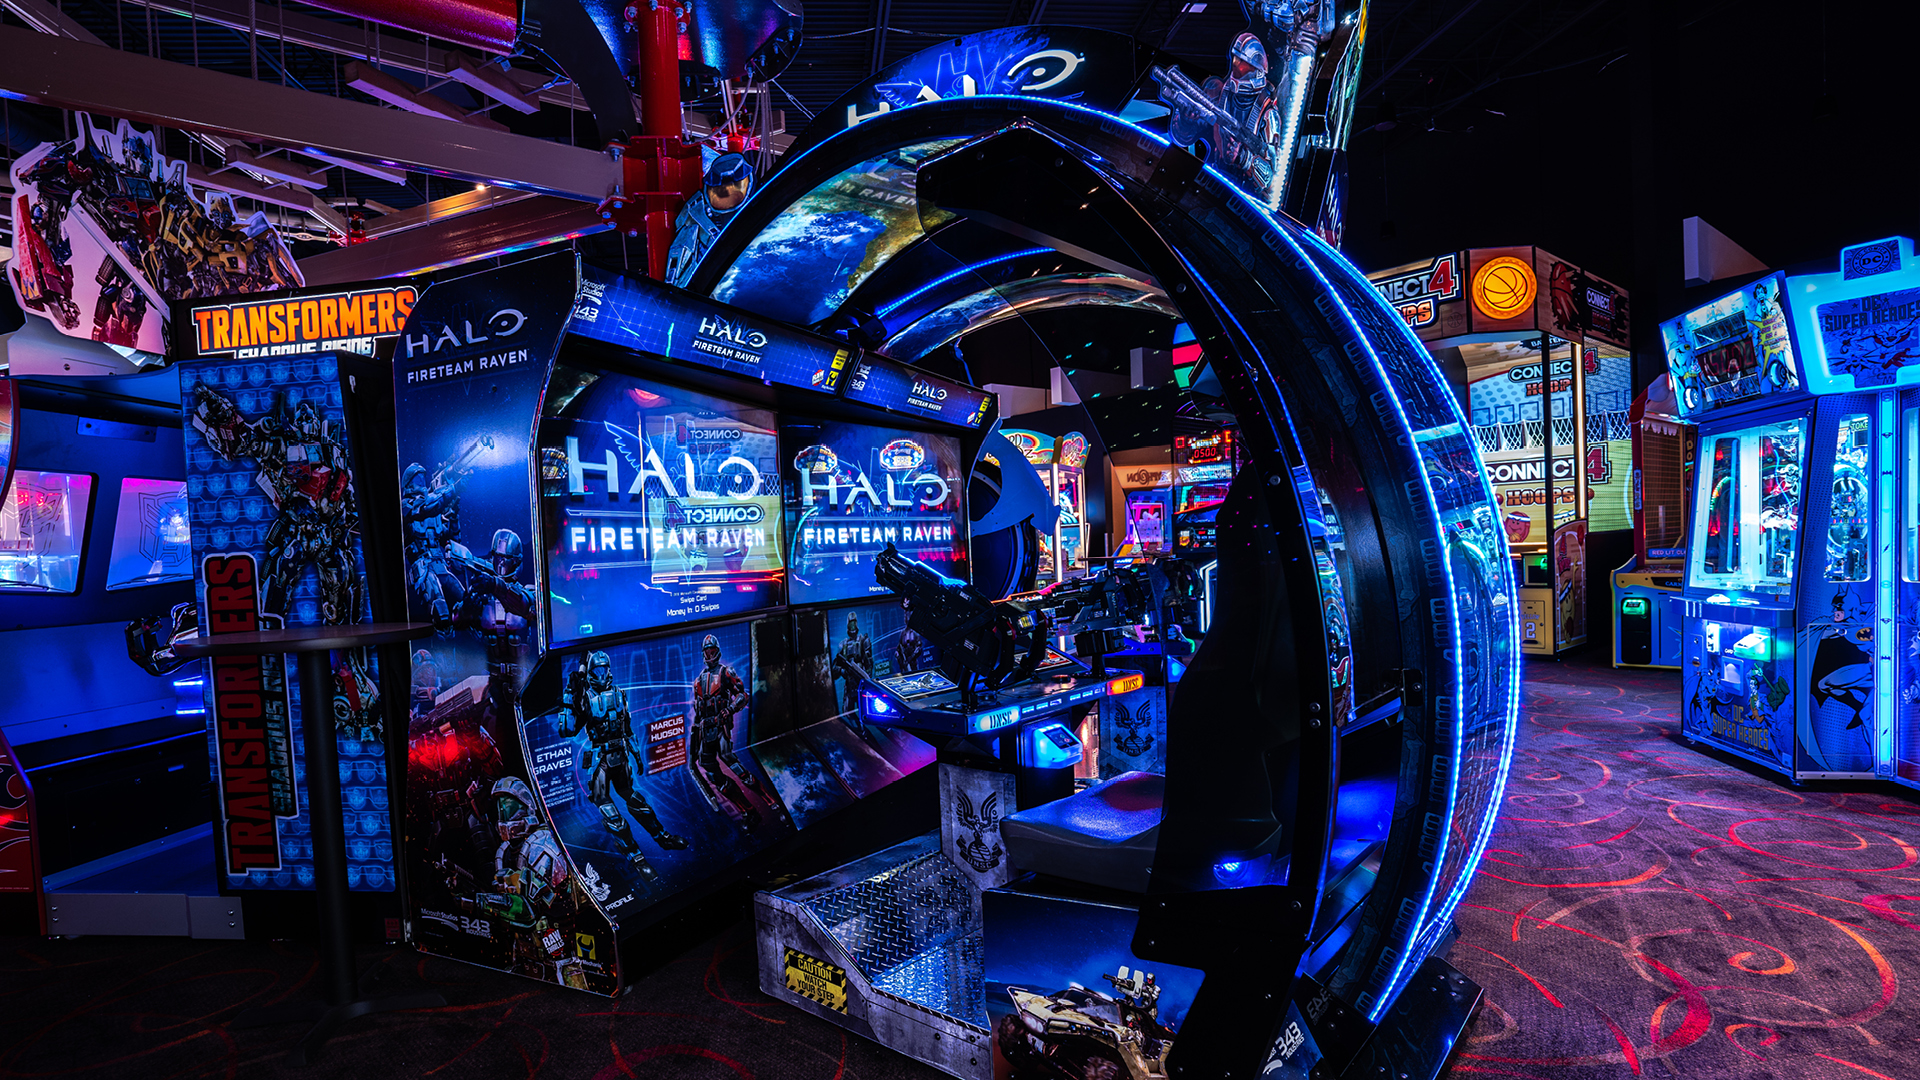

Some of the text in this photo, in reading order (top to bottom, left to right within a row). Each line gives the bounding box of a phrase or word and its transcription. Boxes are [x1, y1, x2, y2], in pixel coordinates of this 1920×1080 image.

[1862, 255, 1881, 265] DC
[1429, 260, 1454, 295] 4
[1862, 295, 1881, 311] DC
[195, 290, 414, 350] TRANSFORMERS
[1824, 312, 1867, 332] SUPER
[406, 308, 528, 358] HALO
[699, 316, 768, 348] HALO
[692, 340, 761, 364] FIRETEAM RAVEN
[1584, 350, 1596, 373] 4
[407, 348, 528, 384] FIRETEAM RAVEN
[912, 382, 947, 400] HALO
[907, 397, 943, 412] FIRETEAM RAVEN
[566, 435, 765, 500] HALO
[1587, 448, 1606, 480] 4
[801, 468, 952, 506] HALO
[571, 526, 698, 551] FIRETEAM
[706, 527, 765, 549] RAVEN
[803, 526, 952, 545] FIRETEAM RAVEN
[1525, 622, 1536, 638] 2
[1122, 677, 1139, 692] UNSC
[651, 716, 684, 732] MARCUS
[988, 711, 1013, 729] UNSC
[1733, 704, 1744, 724] DC
[651, 726, 684, 742] HUDSON
[1713, 711, 1768, 751] SUPER HEROES
[537, 746, 572, 763] ETHAN
[967, 856, 992, 869] UNSC
[605, 893, 635, 912] PROFILE
[460, 915, 491, 933] 343
[542, 929, 561, 948] RAW
[797, 958, 832, 981] CAUTION
[797, 978, 835, 1001] YOUR STEP
[803, 972, 827, 990] WATCH
[1275, 1021, 1301, 1057] 343
